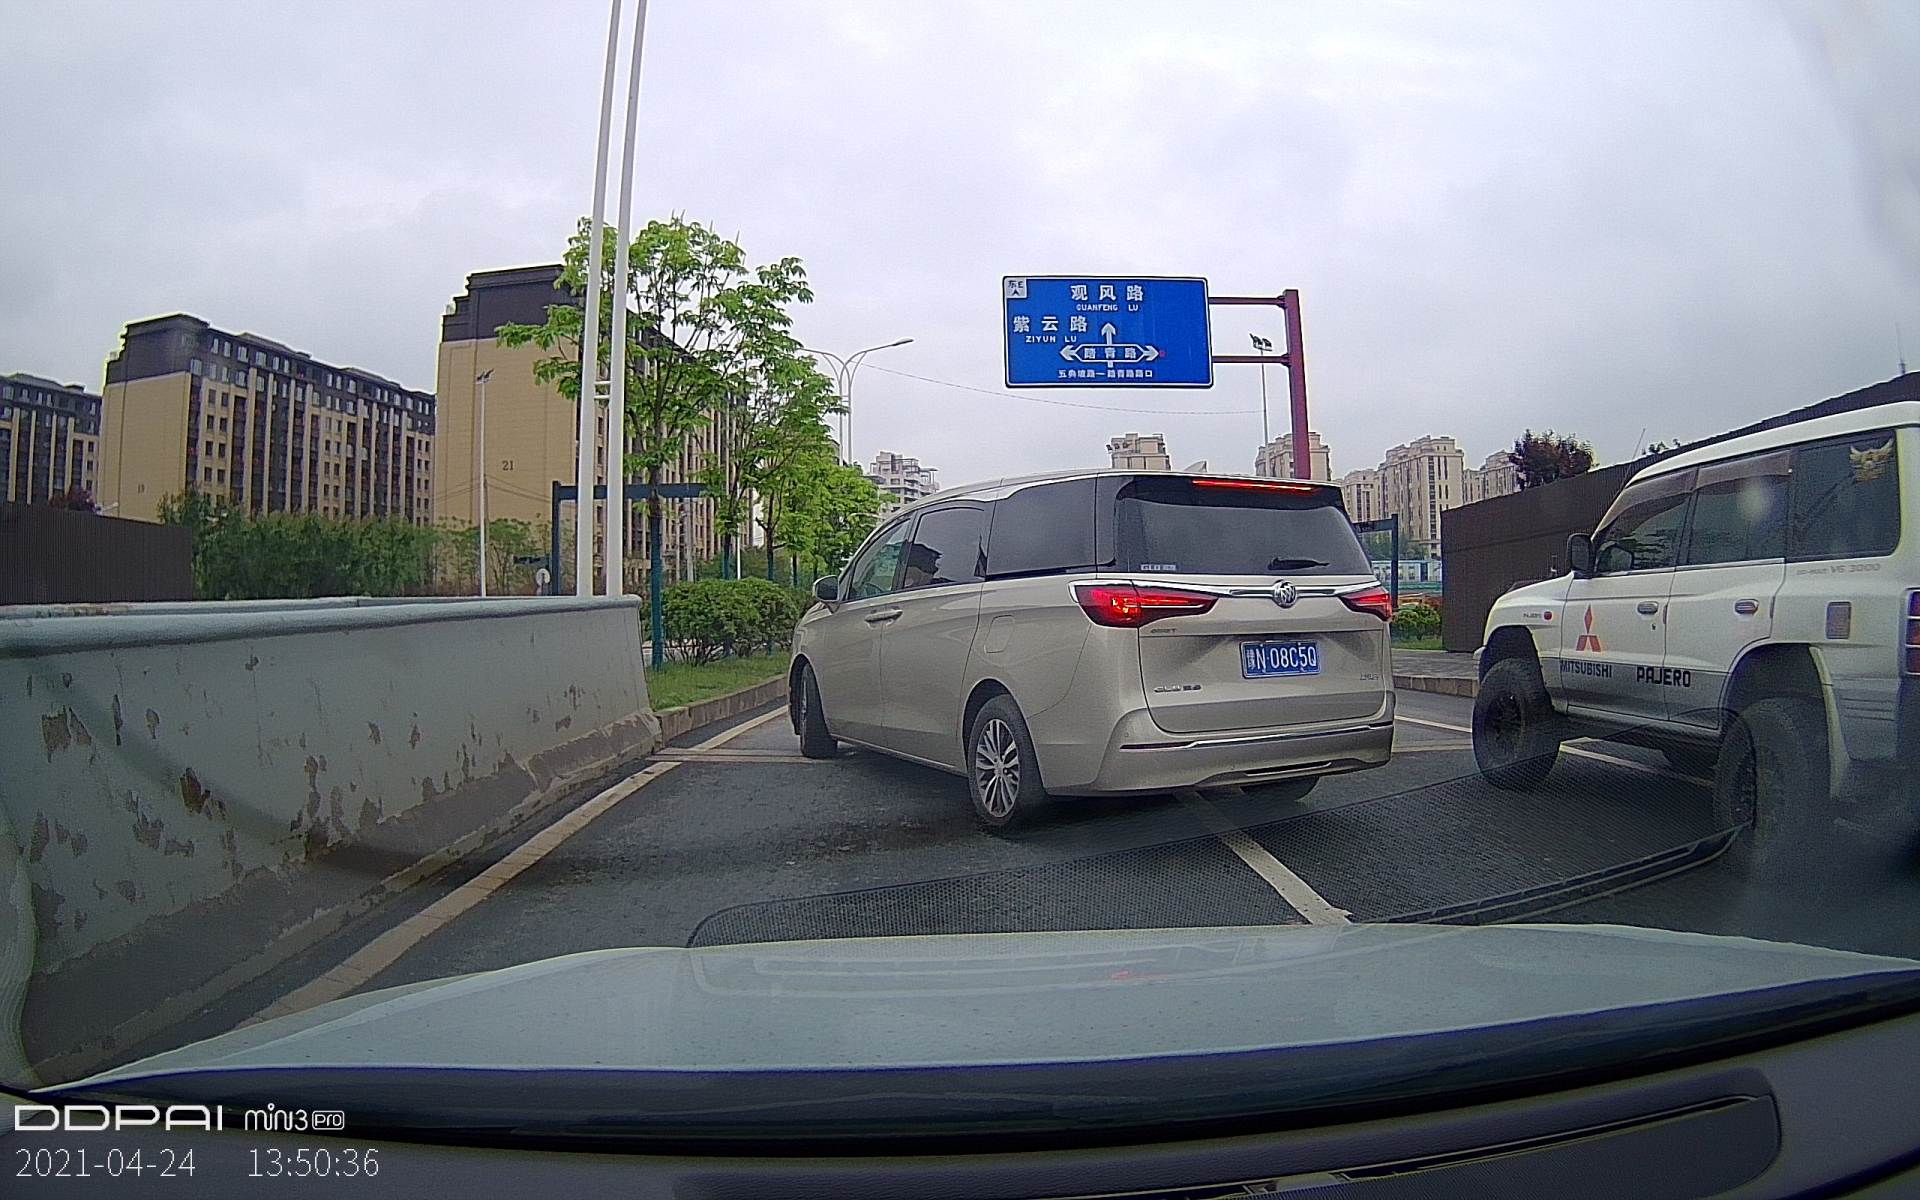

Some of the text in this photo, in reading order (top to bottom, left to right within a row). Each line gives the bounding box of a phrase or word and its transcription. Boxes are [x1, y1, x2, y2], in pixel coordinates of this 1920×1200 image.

[1070, 284, 1144, 301] 观风路
[1076, 303, 1139, 312] GUANFENG LU
[1013, 315, 1088, 333] 紫云路
[1025, 335, 1077, 343] ZIYUN LU
[502, 460, 513, 471] 21
[1560, 660, 1691, 687] MITSUBISHI PAJERO
